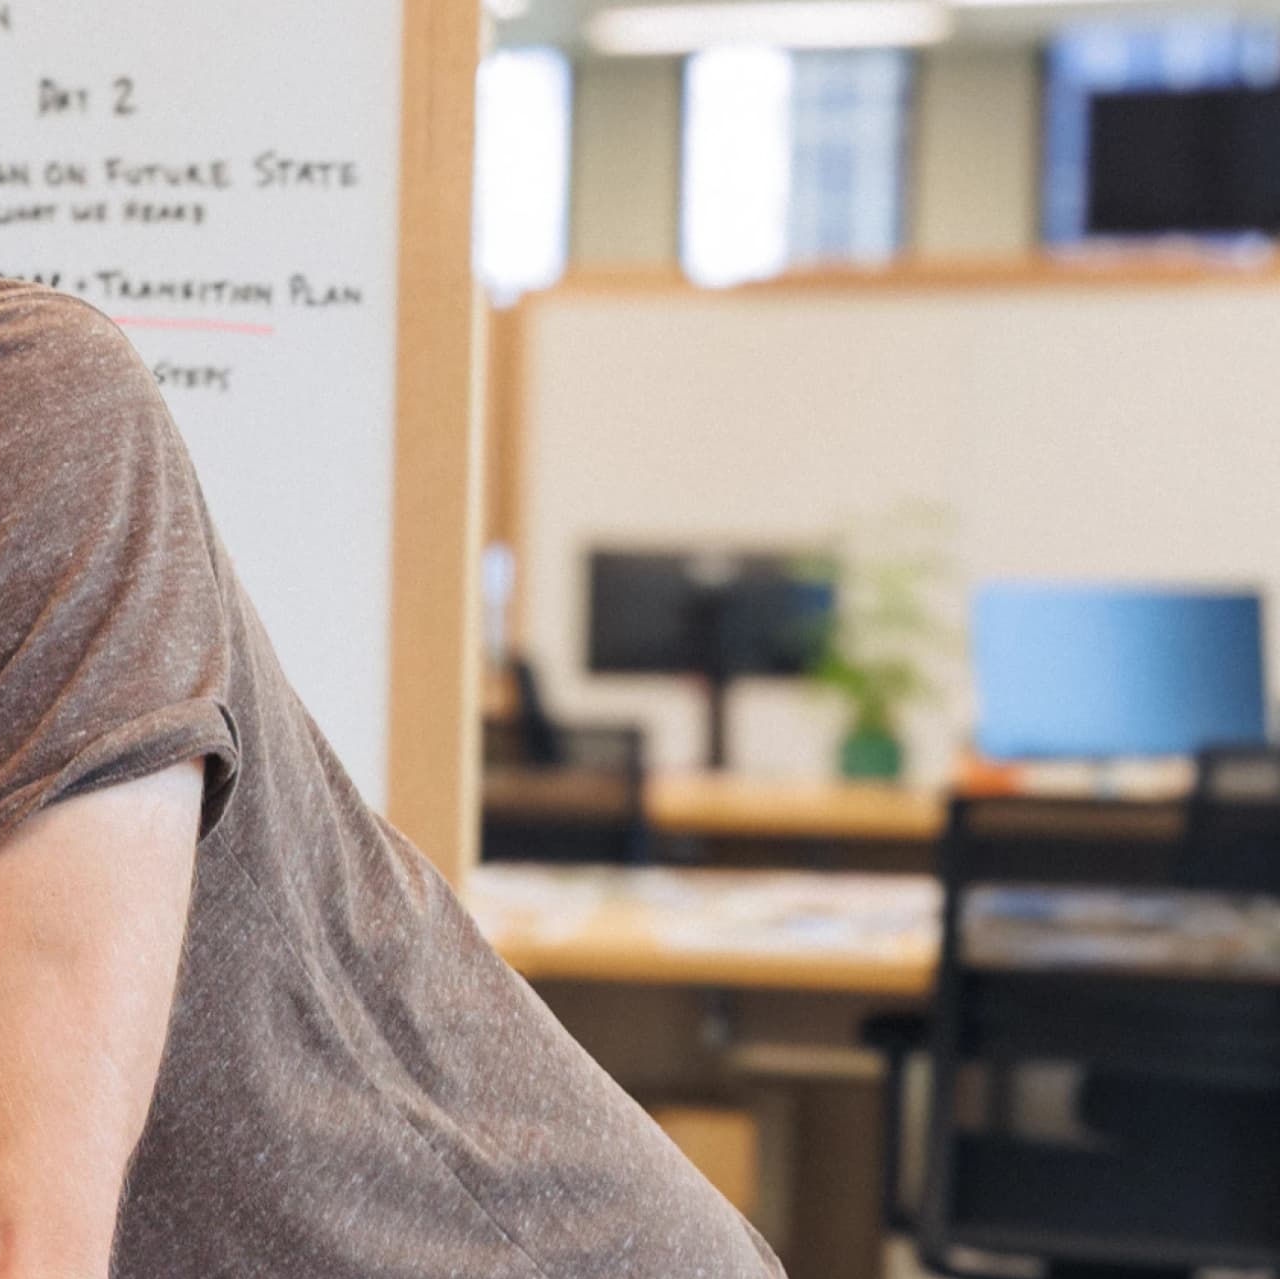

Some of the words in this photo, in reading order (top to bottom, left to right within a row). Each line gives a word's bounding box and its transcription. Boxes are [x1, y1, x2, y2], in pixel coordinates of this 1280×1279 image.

[111, 76, 137, 116] 2
[43, 159, 87, 188] ON
[104, 156, 233, 189] FUTURE
[251, 148, 360, 189] STATE
[289, 272, 365, 307] PLAN
